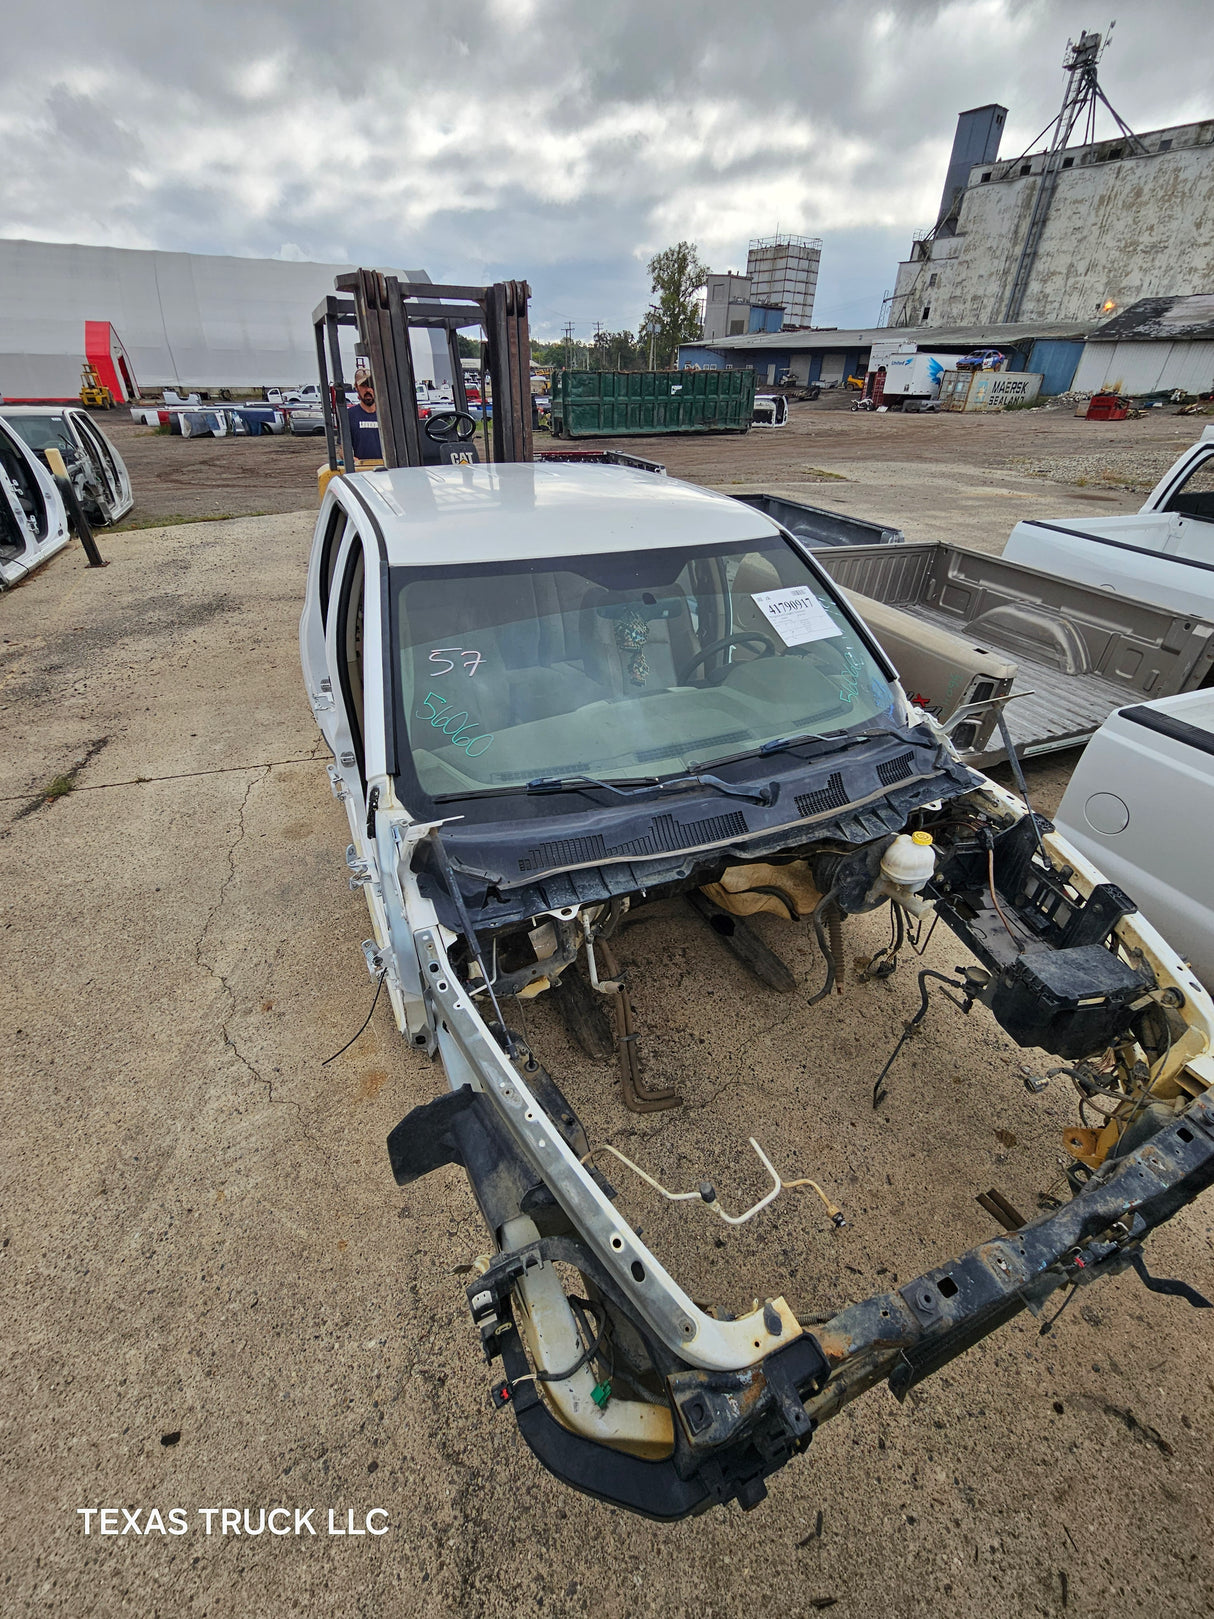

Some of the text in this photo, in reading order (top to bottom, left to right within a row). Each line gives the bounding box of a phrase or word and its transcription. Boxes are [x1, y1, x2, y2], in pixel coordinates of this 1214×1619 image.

[991, 381, 1030, 394] MAERSK
[450, 452, 473, 465] CAT
[768, 597, 814, 615] 41790917
[428, 648, 488, 677] 57
[415, 691, 495, 758] 56060
